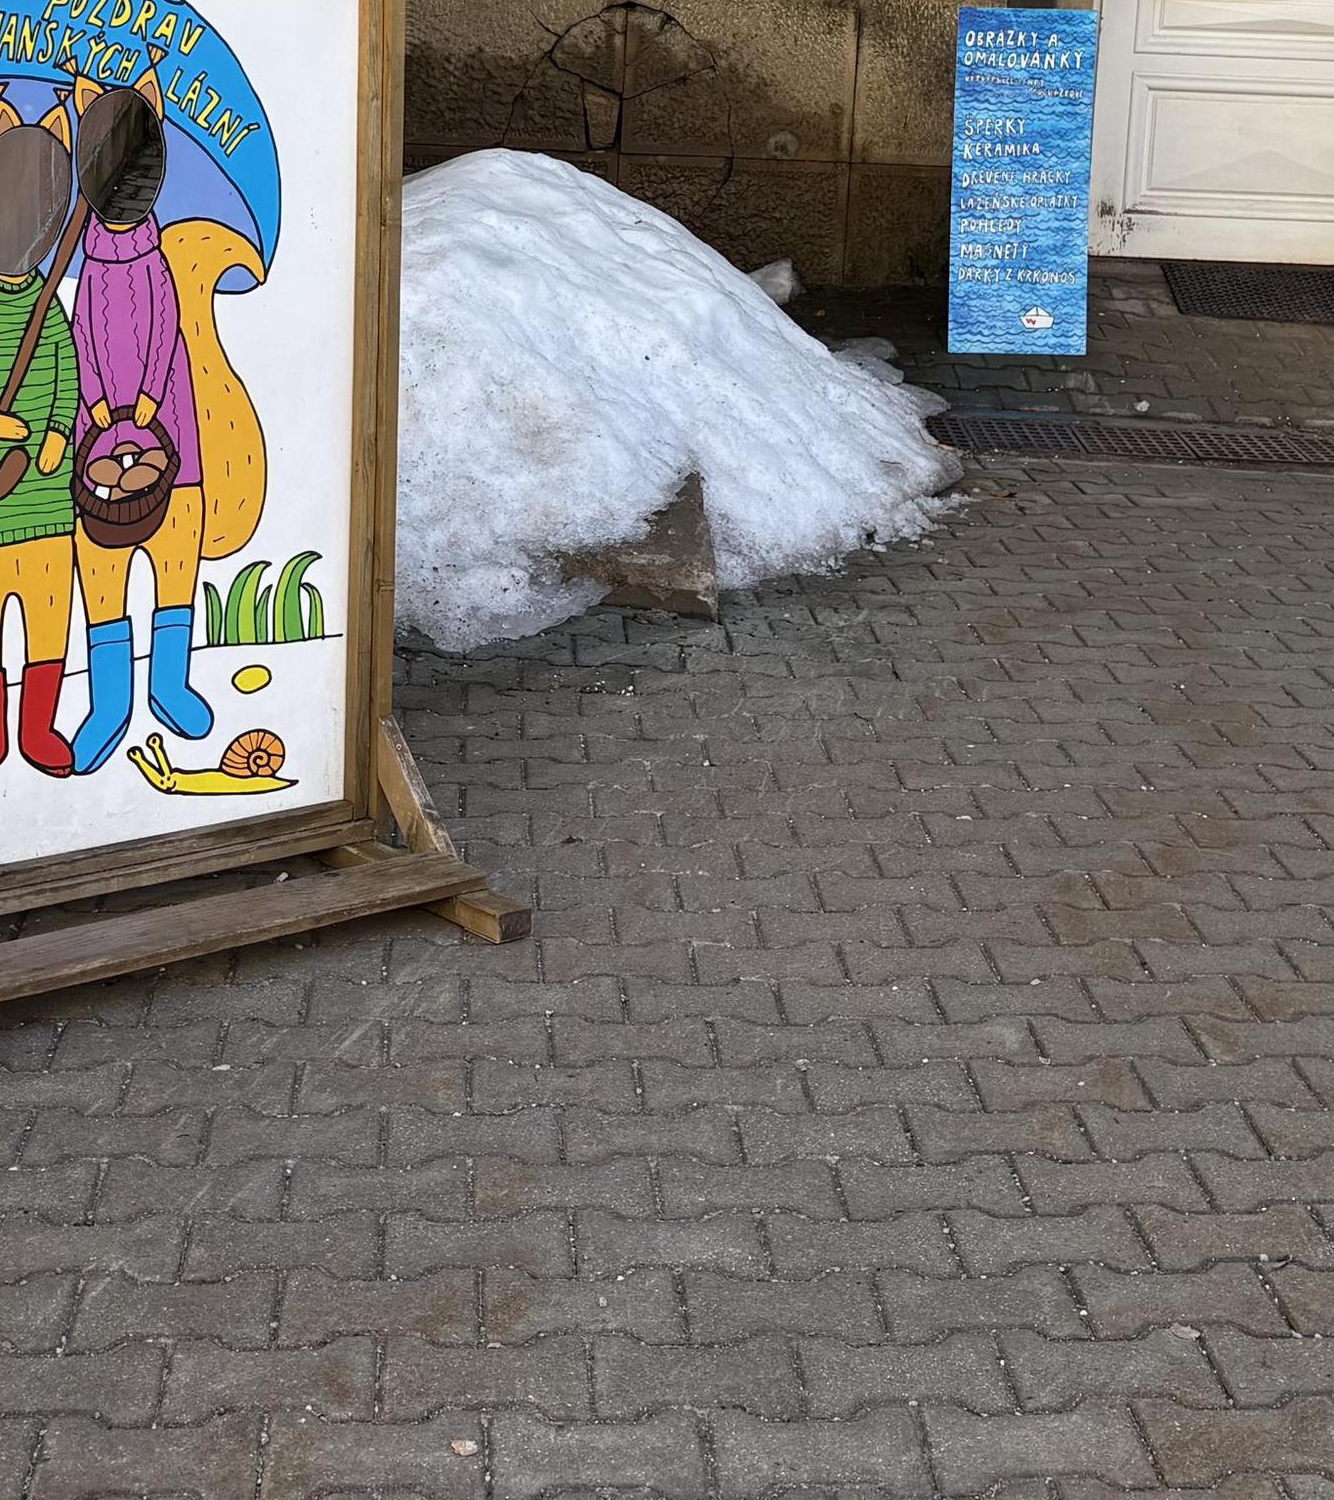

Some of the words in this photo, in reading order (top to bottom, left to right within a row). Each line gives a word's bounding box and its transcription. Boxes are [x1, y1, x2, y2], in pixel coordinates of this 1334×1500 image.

[965, 29, 1038, 48] OBRÁZKY
[1048, 34, 1058, 47] A
[964, 50, 1083, 69] OMALOVÁNKY
[165, 67, 261, 157] LÁZNÍ
[965, 115, 1026, 135] ŠPERKY
[963, 143, 1040, 160] KERAMIKA
[1030, 195, 1078, 208] OPLATKY
[960, 219, 1022, 233] POHLEDY
[960, 243, 1028, 259] MAGNETY
[1005, 268, 1013, 280] Z
